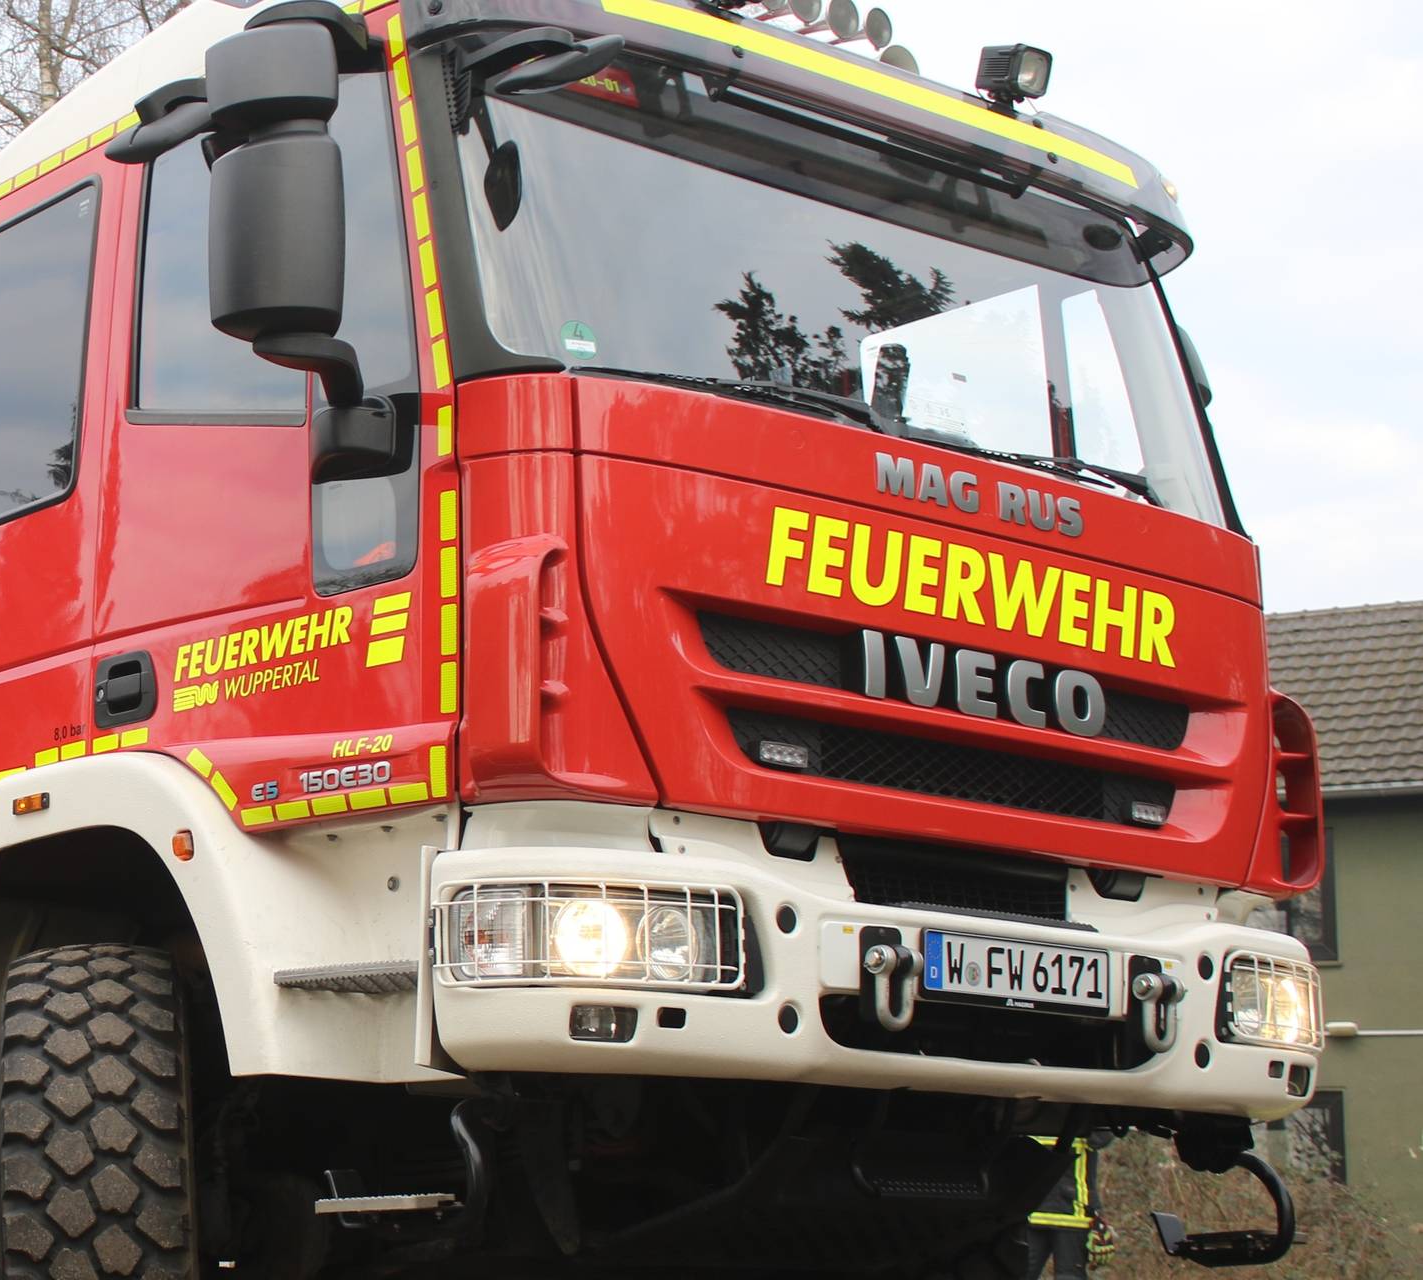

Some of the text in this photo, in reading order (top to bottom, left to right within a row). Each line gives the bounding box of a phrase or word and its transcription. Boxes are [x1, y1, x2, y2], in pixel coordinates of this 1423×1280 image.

[876, 451, 1084, 537] MAG RUS
[765, 505, 1176, 668] FEUERWEHR
[174, 606, 353, 682] FEUERWEHR
[224, 658, 320, 700] WUPPERTAL
[862, 628, 1106, 737] IVECO
[54, 723, 86, 742] 8,0 bar
[332, 734, 393, 758] HLF-20
[251, 761, 392, 801] E5 150E30
[931, 966, 938, 979] D
[946, 941, 1102, 999] W FW 6171
